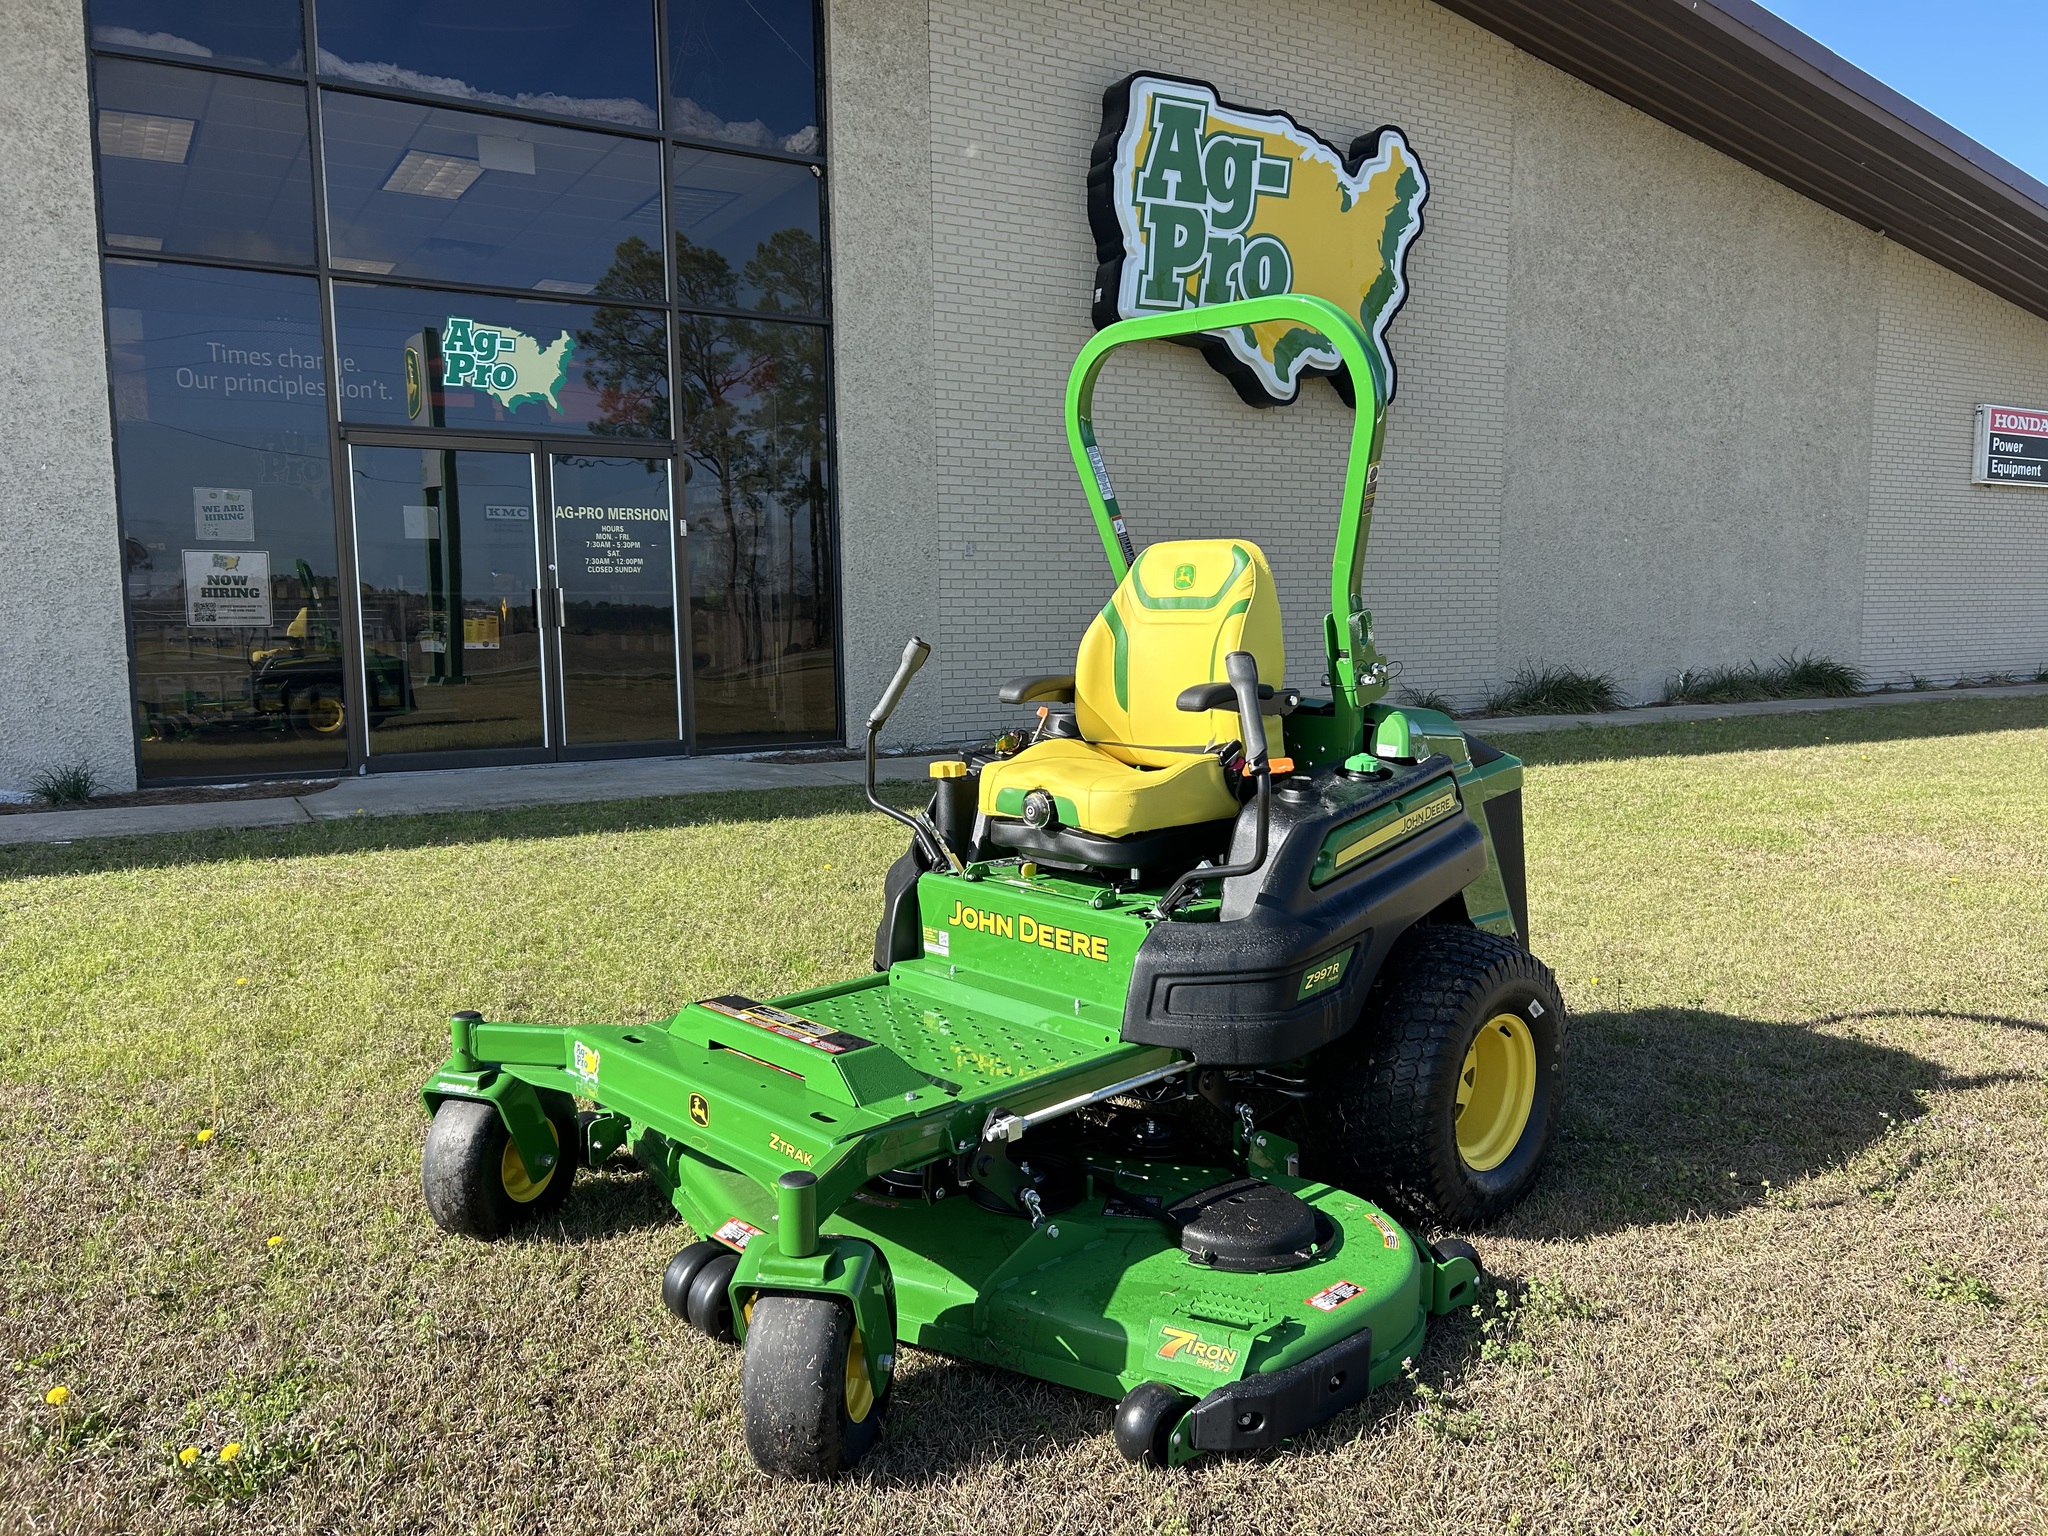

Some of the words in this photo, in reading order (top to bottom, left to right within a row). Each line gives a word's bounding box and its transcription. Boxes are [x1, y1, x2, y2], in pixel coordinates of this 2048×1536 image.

[1138, 98, 1290, 231] Ag-
[1139, 203, 1292, 308] Pro
[443, 317, 516, 362] Ag-
[206, 342, 272, 367] Times
[278, 348, 361, 375] chane.
[443, 353, 517, 390] Pro
[176, 367, 218, 389] Our
[224, 373, 326, 400] principles
[1994, 413, 2048, 432] HONDA
[1992, 437, 2024, 453] Power
[1991, 459, 2042, 478] Equipment
[202, 505, 221, 513] WE
[223, 504, 245, 512] ARE
[204, 513, 245, 521] HIRING
[488, 507, 528, 518] KMC
[555, 506, 604, 520] AG-PRO
[607, 507, 669, 521] MERSHON
[601, 525, 625, 533] HOURS
[607, 549, 621, 557] SAT.
[616, 541, 641, 549] 5:30PM
[585, 557, 610, 565] 7:30AM
[207, 575, 249, 586] NOW
[201, 587, 261, 599] HIRING
[1400, 811, 1424, 833] JOHN
[1424, 798, 1452, 820] DEERE
[948, 900, 1014, 940] JOHN
[1018, 914, 1109, 962] DEERE
[1304, 962, 1340, 990] Z997R
[768, 1131, 814, 1167] ZTRAK
[1158, 1326, 1199, 1359] 7
[1185, 1339, 1238, 1365] IRON
[1196, 1358, 1216, 1369] PRO
